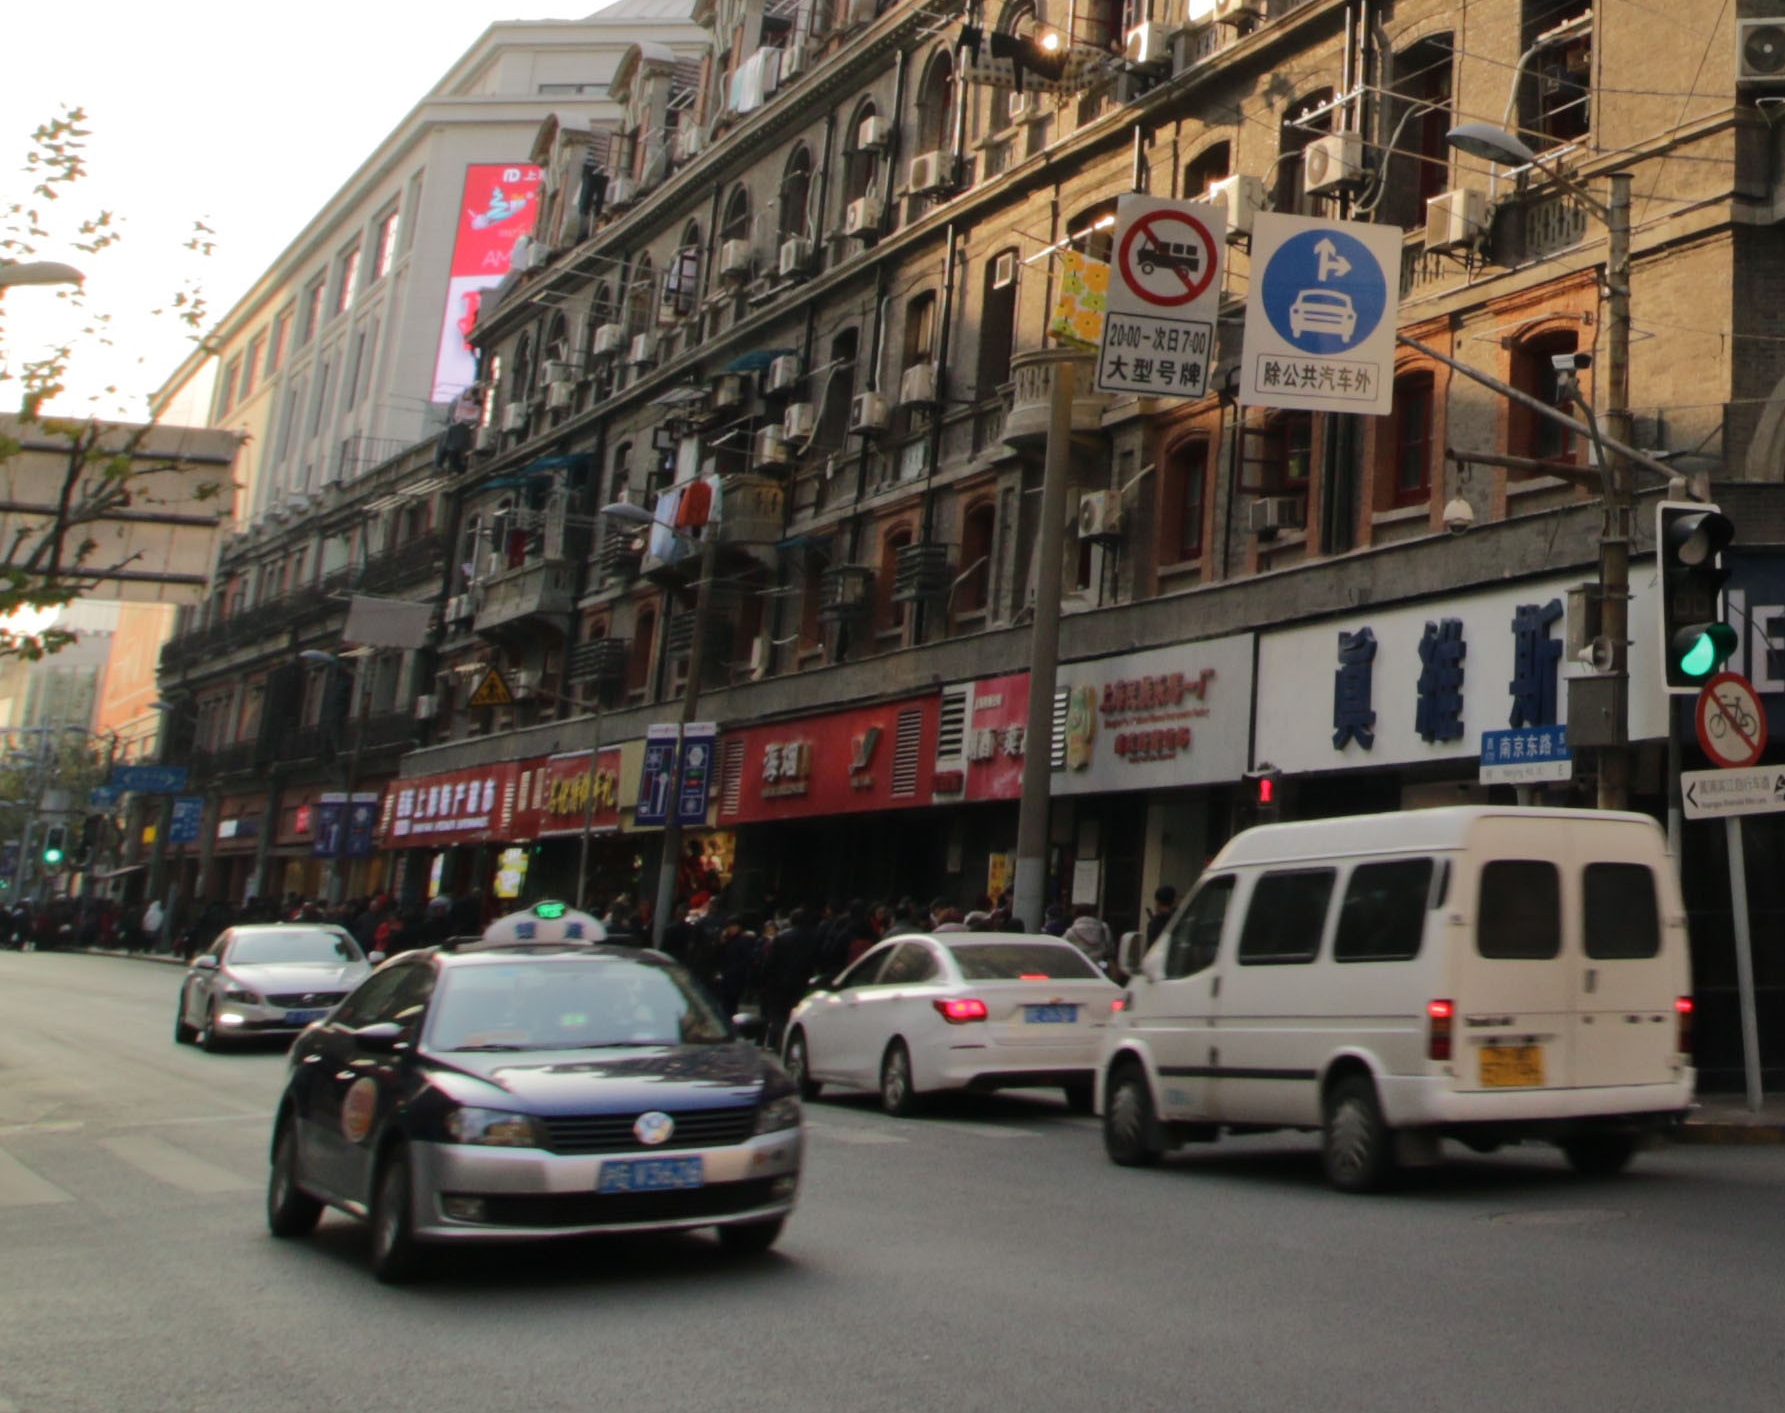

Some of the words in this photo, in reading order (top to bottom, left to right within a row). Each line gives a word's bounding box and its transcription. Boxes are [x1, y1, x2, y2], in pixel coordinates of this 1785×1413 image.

[1106, 355, 1202, 387] 大型号牌
[1263, 361, 1372, 394] 除公共汽车外
[1498, 732, 1552, 759] 南京东路
